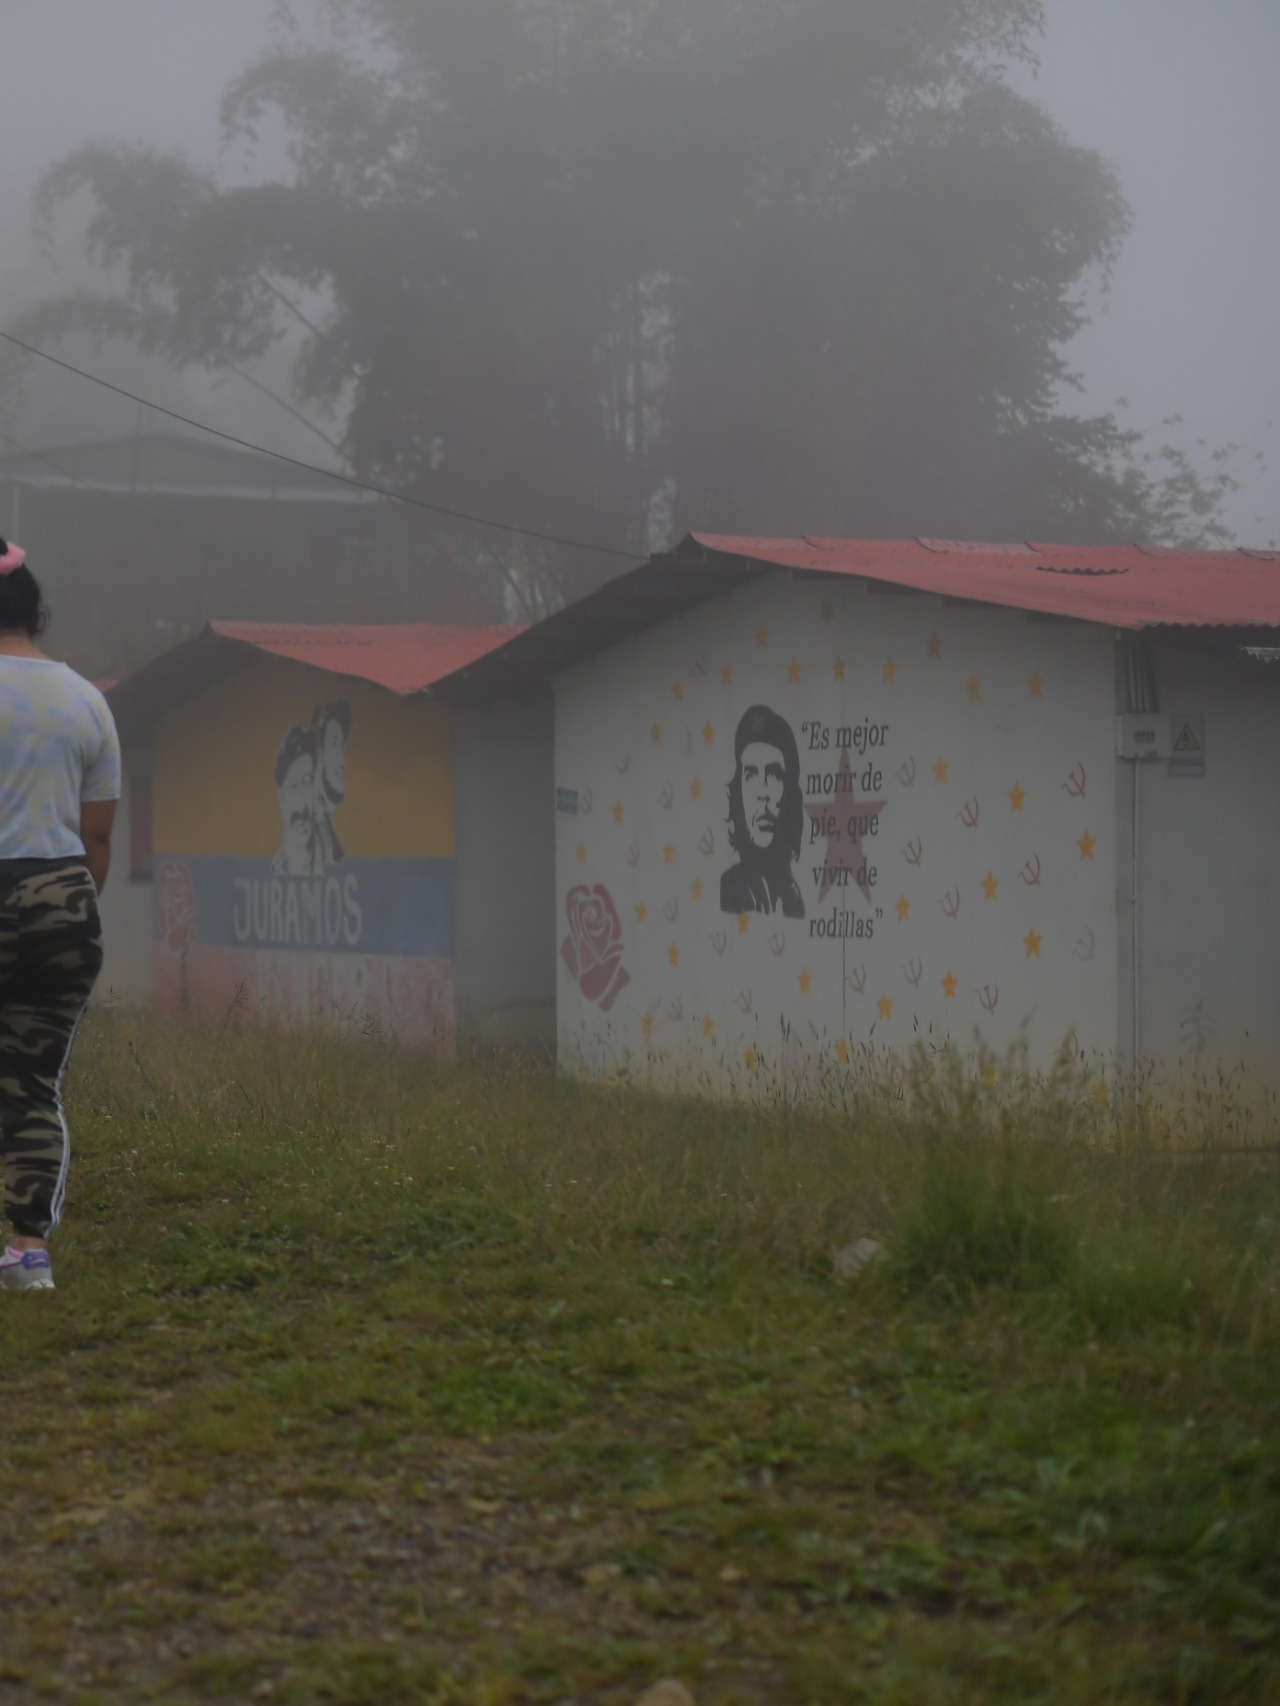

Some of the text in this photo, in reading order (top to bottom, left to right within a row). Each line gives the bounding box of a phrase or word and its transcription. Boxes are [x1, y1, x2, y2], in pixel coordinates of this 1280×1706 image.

[835, 717, 888, 755] mejor
[806, 762, 882, 795] morir de
[809, 809, 879, 845] pie, que
[812, 857, 878, 887] vivir de
[233, 873, 363, 946] JURAMOS
